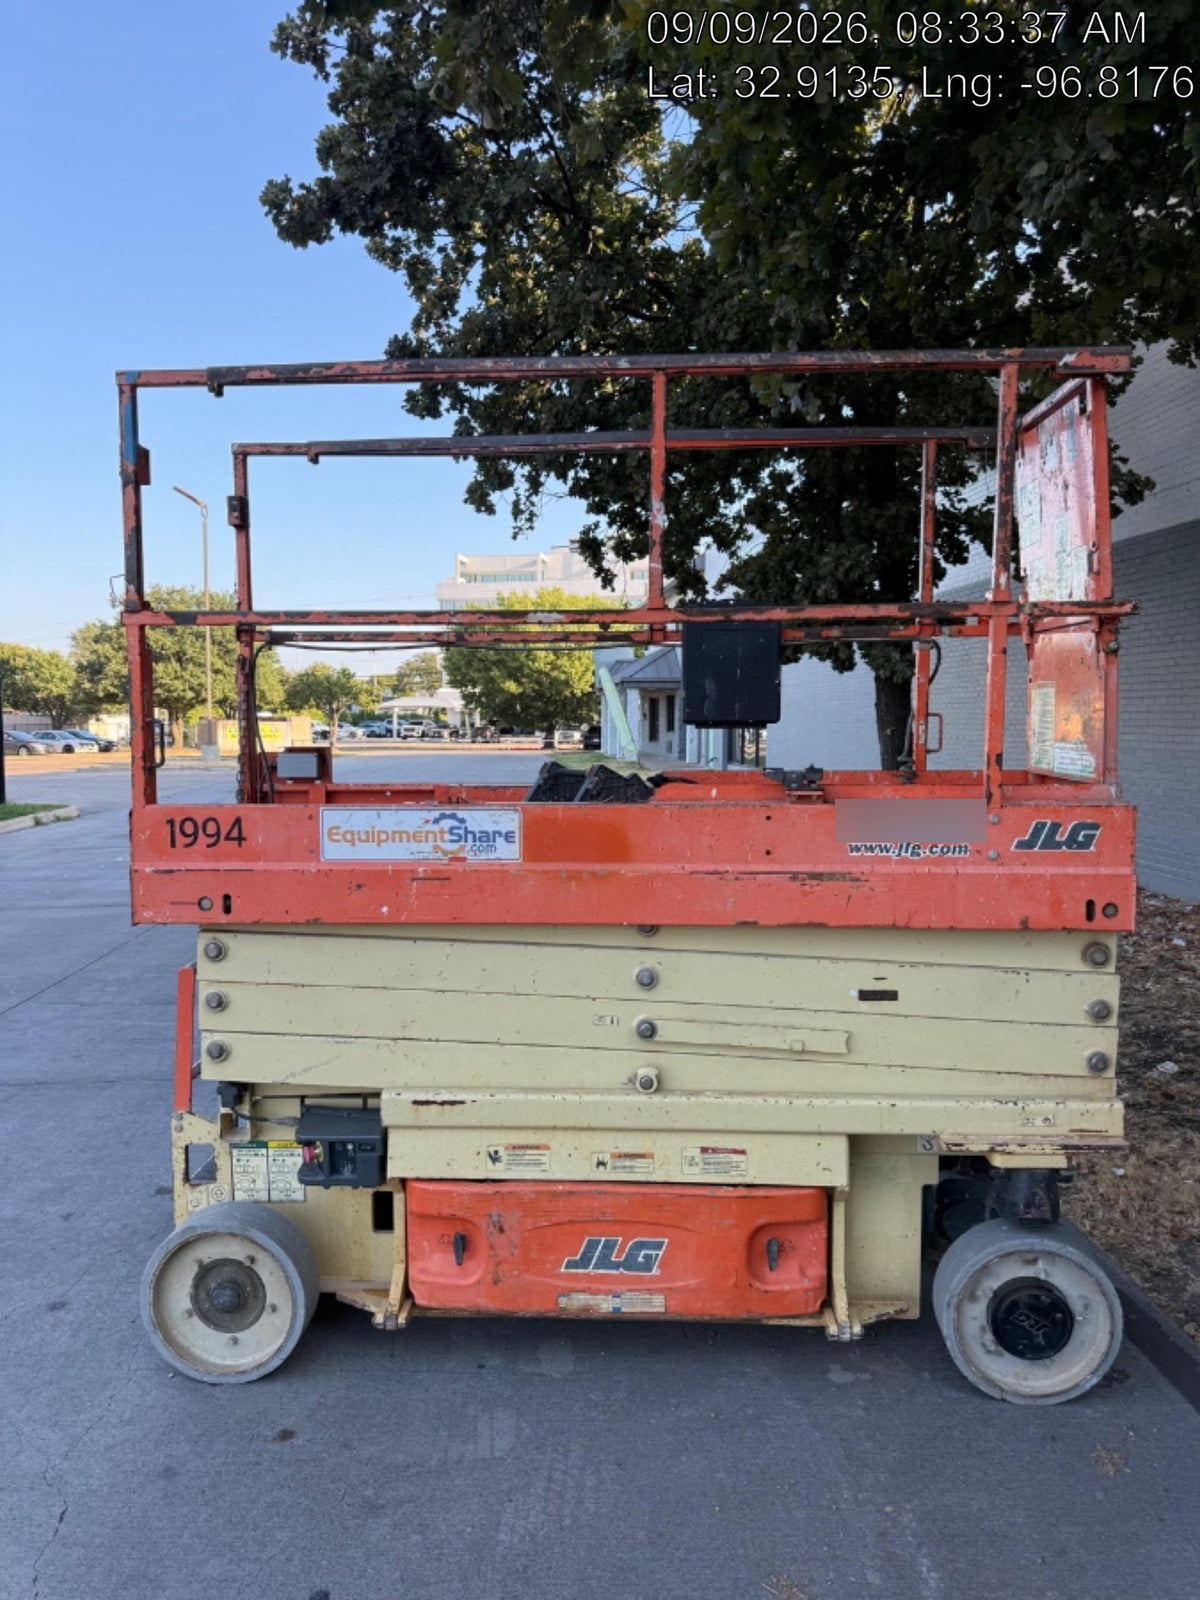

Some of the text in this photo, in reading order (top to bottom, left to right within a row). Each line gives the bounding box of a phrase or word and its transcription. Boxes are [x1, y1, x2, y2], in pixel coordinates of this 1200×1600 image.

[165, 816, 247, 848] 1994
[326, 825, 516, 847] EquipmentShare
[1011, 820, 1101, 851] JLG
[848, 841, 969, 858] www.jlg.com
[560, 1236, 669, 1276] JLG
